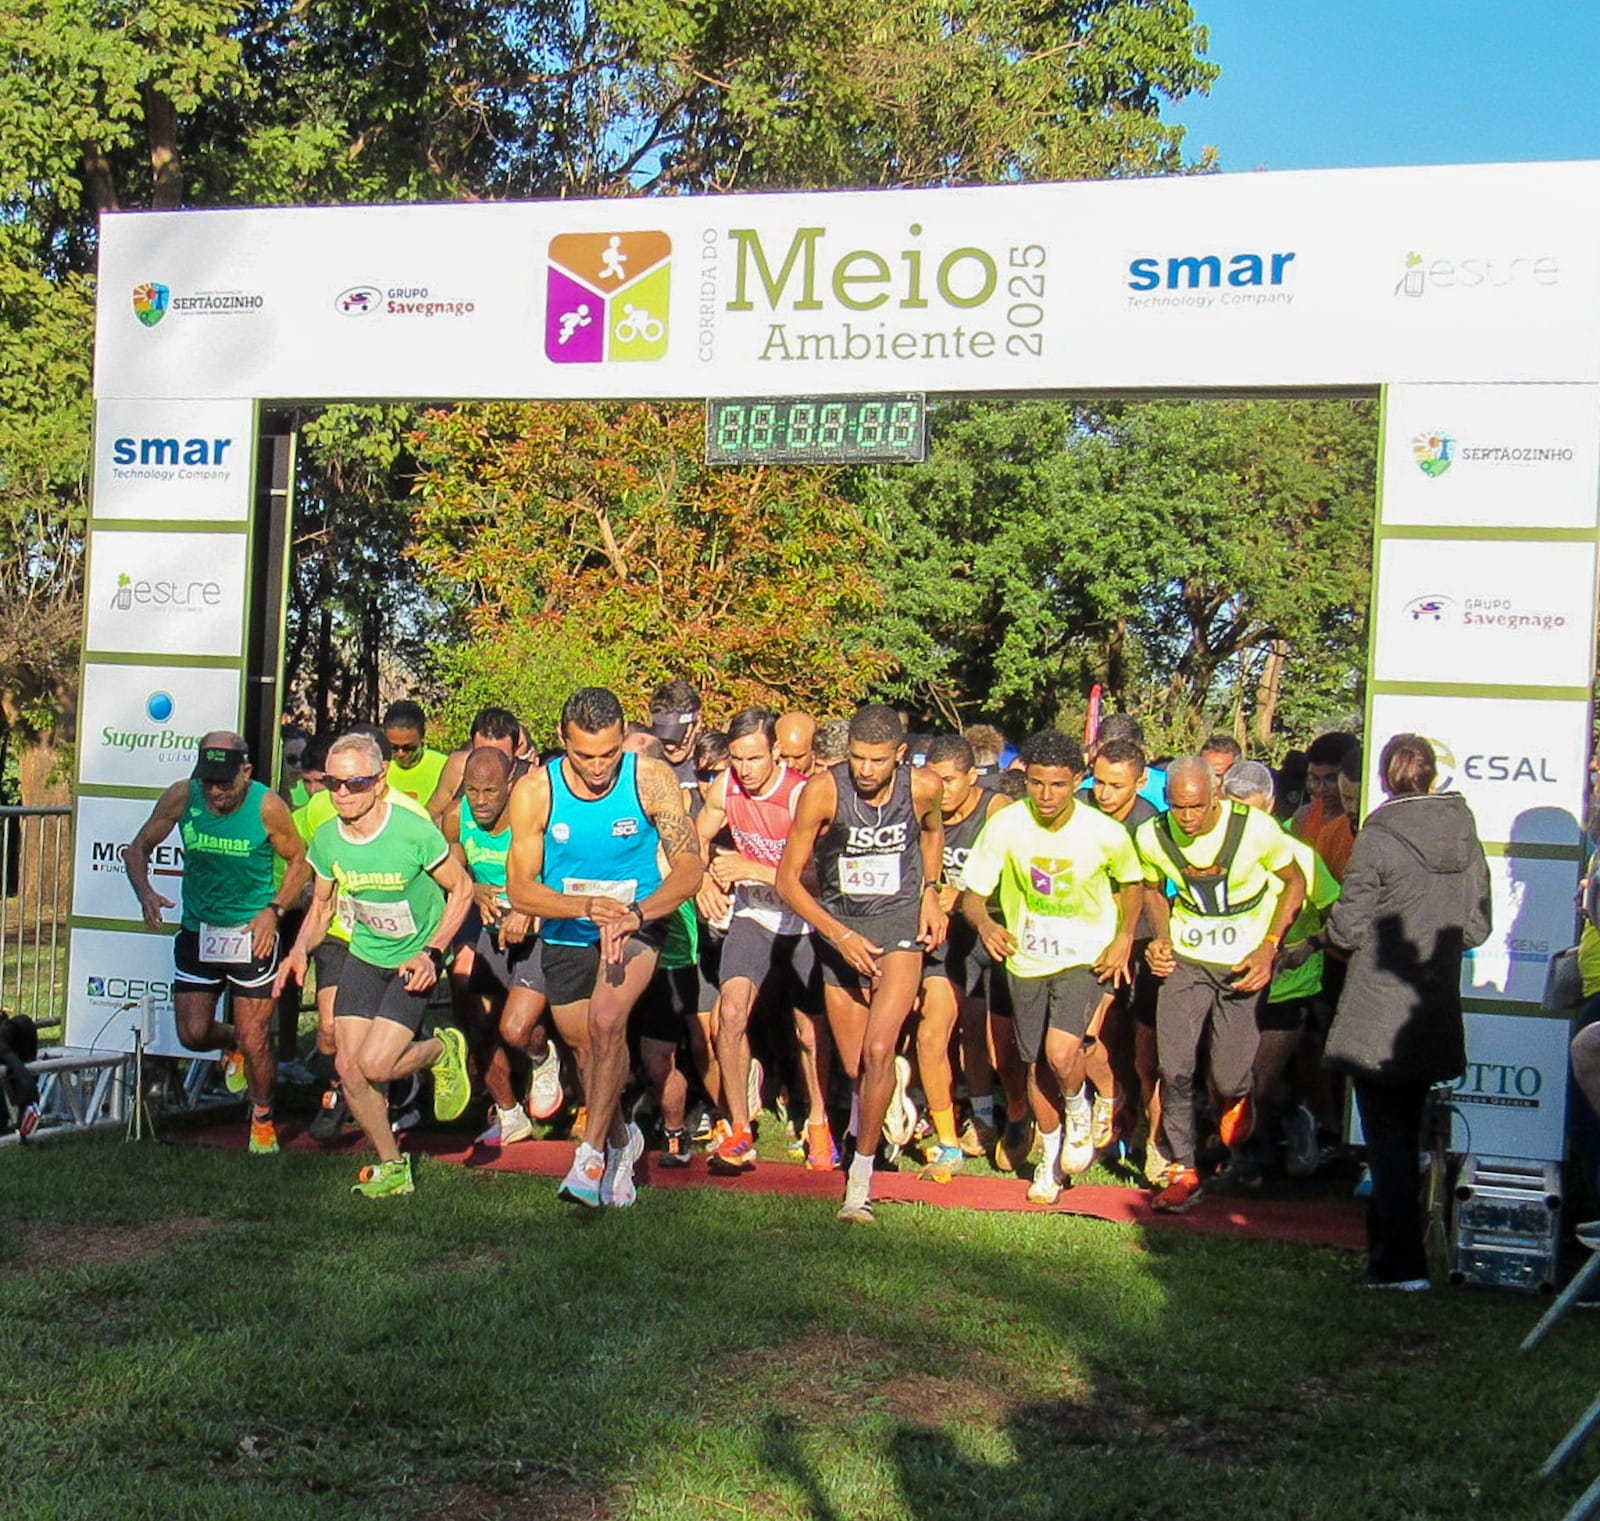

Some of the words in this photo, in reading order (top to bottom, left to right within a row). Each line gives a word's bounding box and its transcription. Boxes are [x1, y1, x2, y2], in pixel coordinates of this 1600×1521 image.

[702, 228, 718, 259] DO
[726, 223, 998, 311] Meio
[1128, 252, 1296, 291] smar
[387, 288, 429, 299] GRUPO
[1006, 244, 1046, 356] 2025
[1127, 294, 1216, 309] Technology
[1220, 291, 1296, 306] Company
[387, 300, 475, 318] Savegnago
[699, 265, 717, 362] CORRIDA
[757, 322, 996, 361] Ambiente
[113, 437, 232, 466] smar
[112, 468, 175, 480] Technology
[177, 468, 231, 481] Company
[1464, 599, 1512, 610] GRUPO
[1463, 612, 1566, 629] Savegnago
[1464, 754, 1558, 783] ESAL
[847, 822, 907, 848] ISCE
[847, 871, 890, 888] 497
[206, 935, 245, 955] 277
[1026, 933, 1060, 956] 211
[1188, 927, 1237, 948] 910
